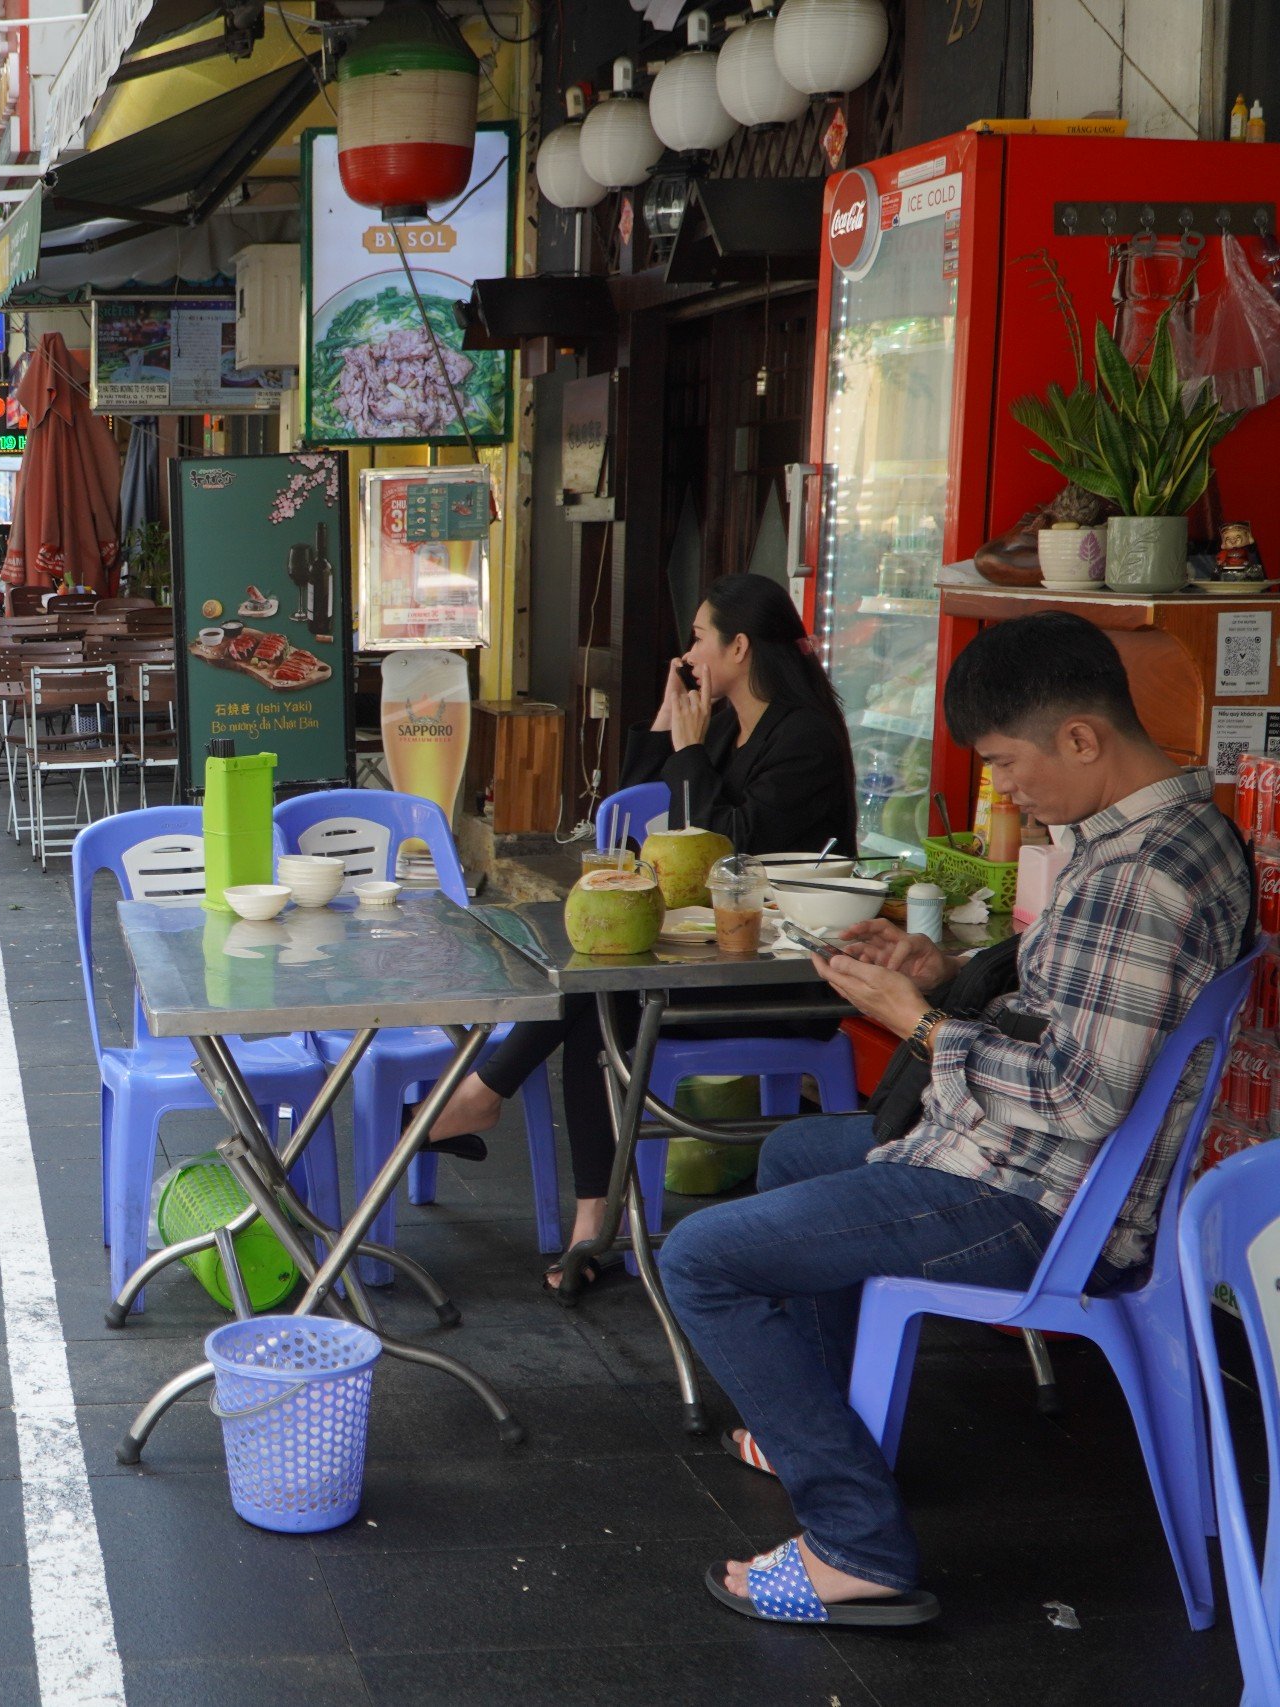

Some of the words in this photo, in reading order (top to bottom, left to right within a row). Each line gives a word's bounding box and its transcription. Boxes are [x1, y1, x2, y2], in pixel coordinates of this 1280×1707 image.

[908, 194, 923, 212] ICE
[927, 185, 956, 207] COLD
[375, 231, 400, 247] BY
[407, 230, 447, 247] SOL
[215, 703, 251, 716] 石焼き
[256, 702, 280, 716] (Ishi
[284, 701, 312, 714] Yaki)
[398, 725, 453, 737] SAPPORO
